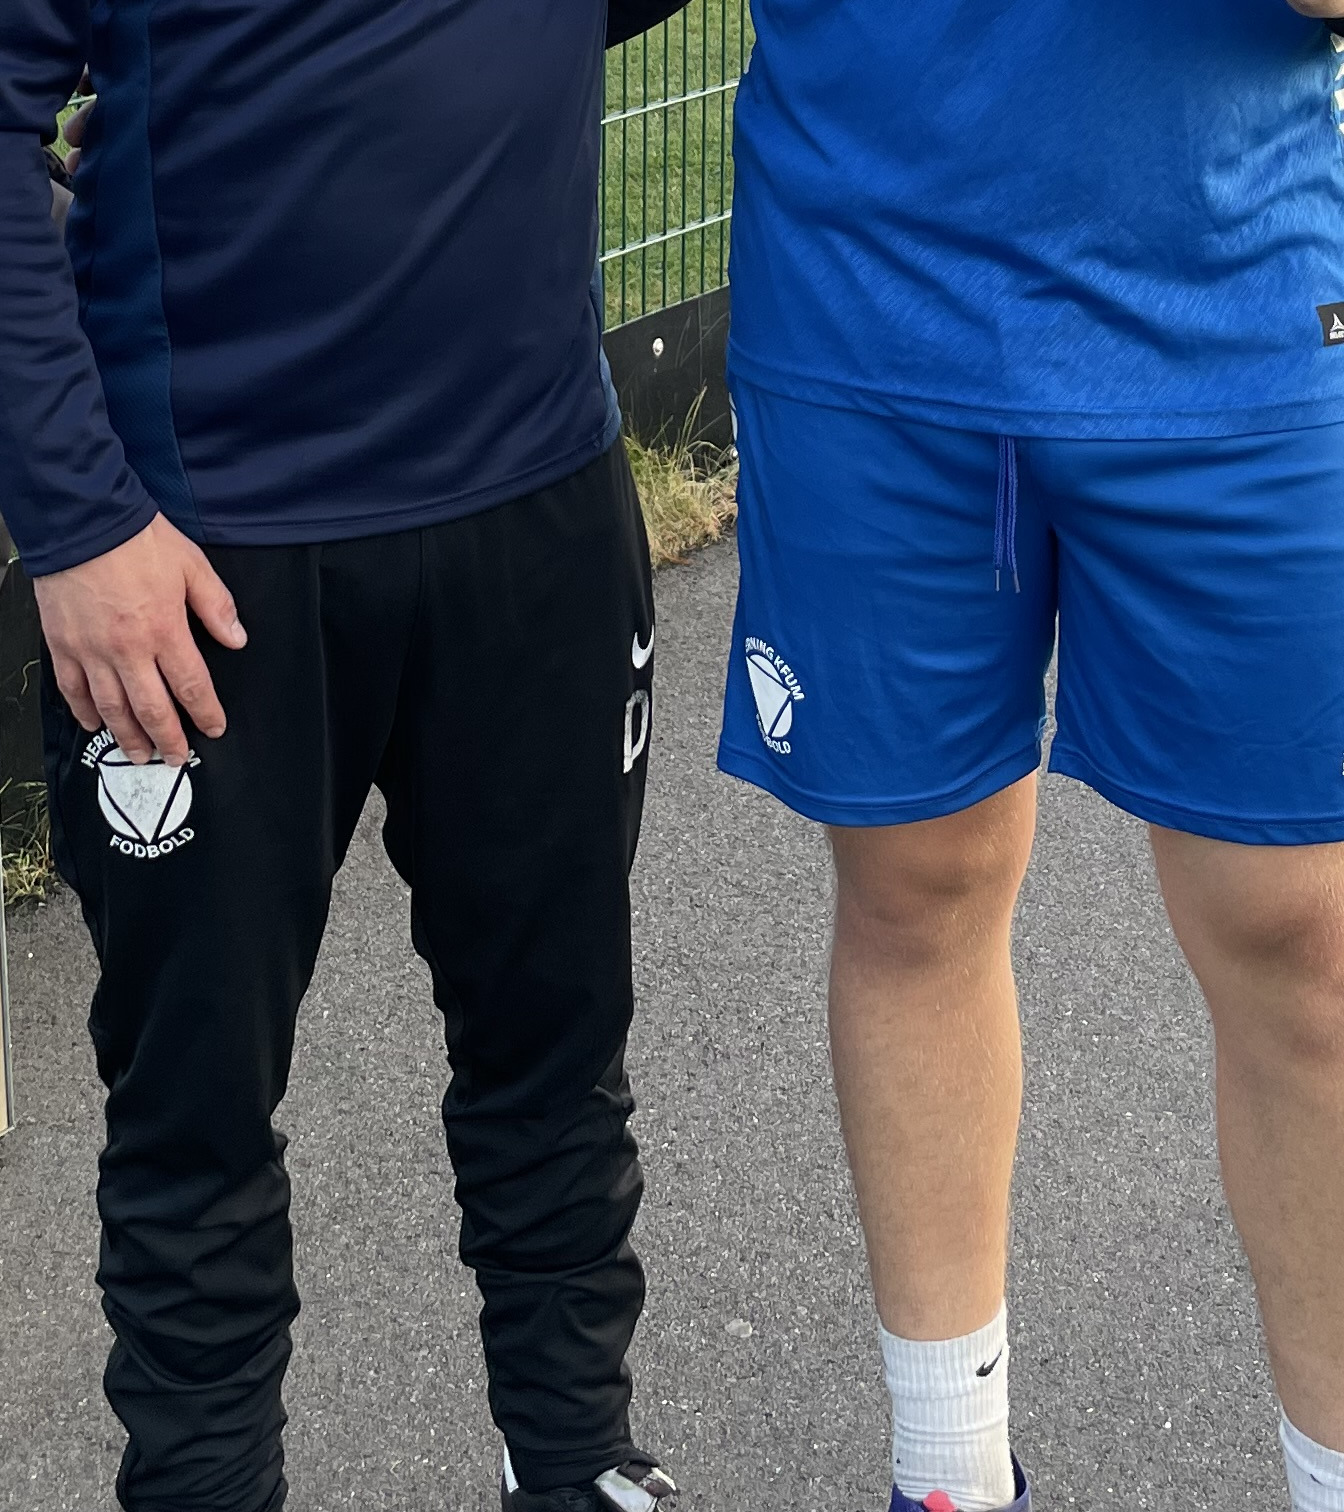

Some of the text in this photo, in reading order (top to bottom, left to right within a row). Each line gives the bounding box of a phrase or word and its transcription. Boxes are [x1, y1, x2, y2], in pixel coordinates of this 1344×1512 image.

[773, 654, 805, 701] KFUM
[80, 728, 116, 769] HERN
[109, 827, 195, 859] FODBOLD
